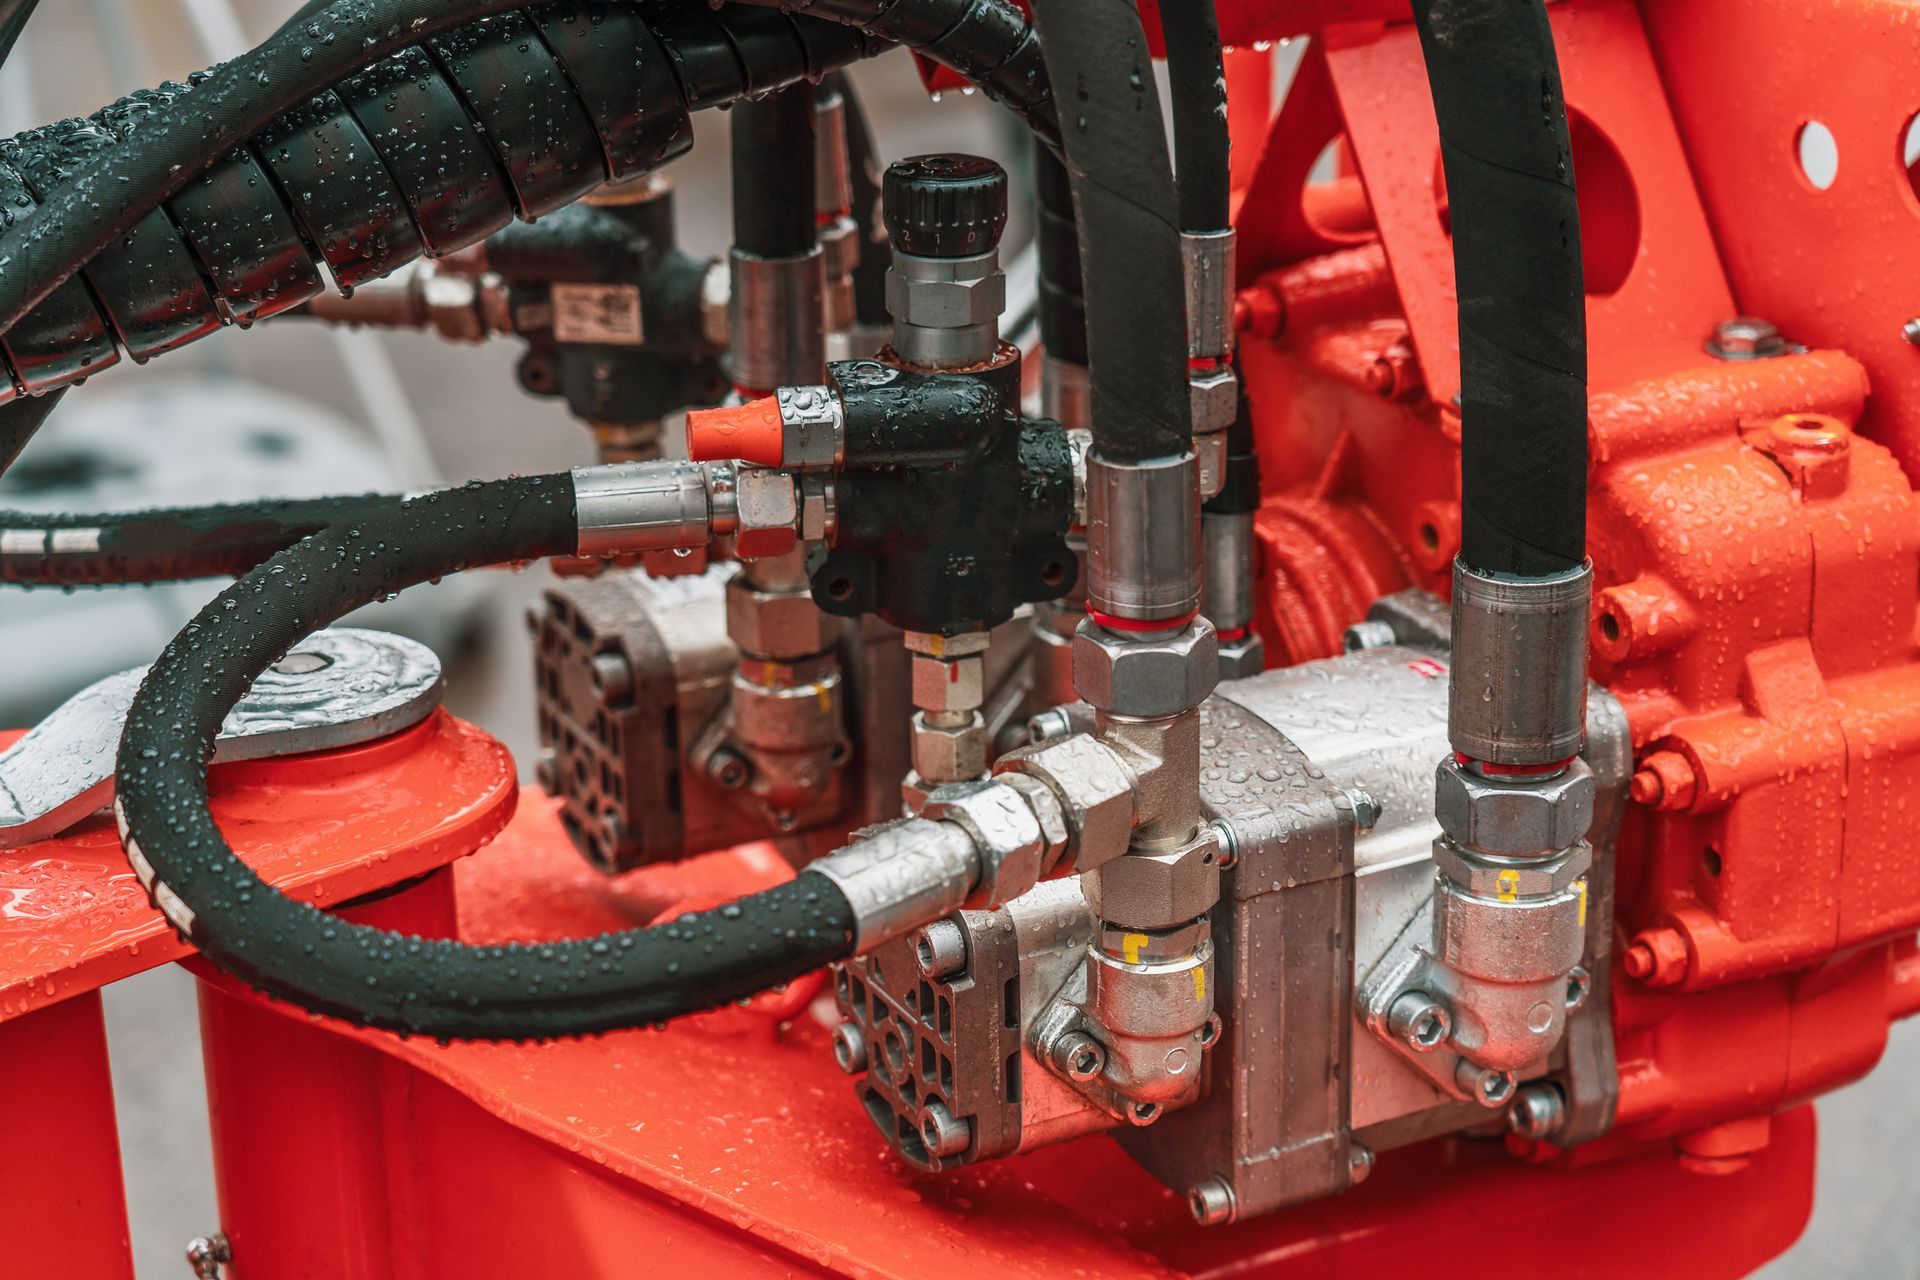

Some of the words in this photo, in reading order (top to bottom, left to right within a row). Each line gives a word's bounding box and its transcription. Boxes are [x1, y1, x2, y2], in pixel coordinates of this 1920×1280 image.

[901, 229, 911, 242] 2
[934, 233, 941, 244] 1
[967, 231, 976, 243] 0
